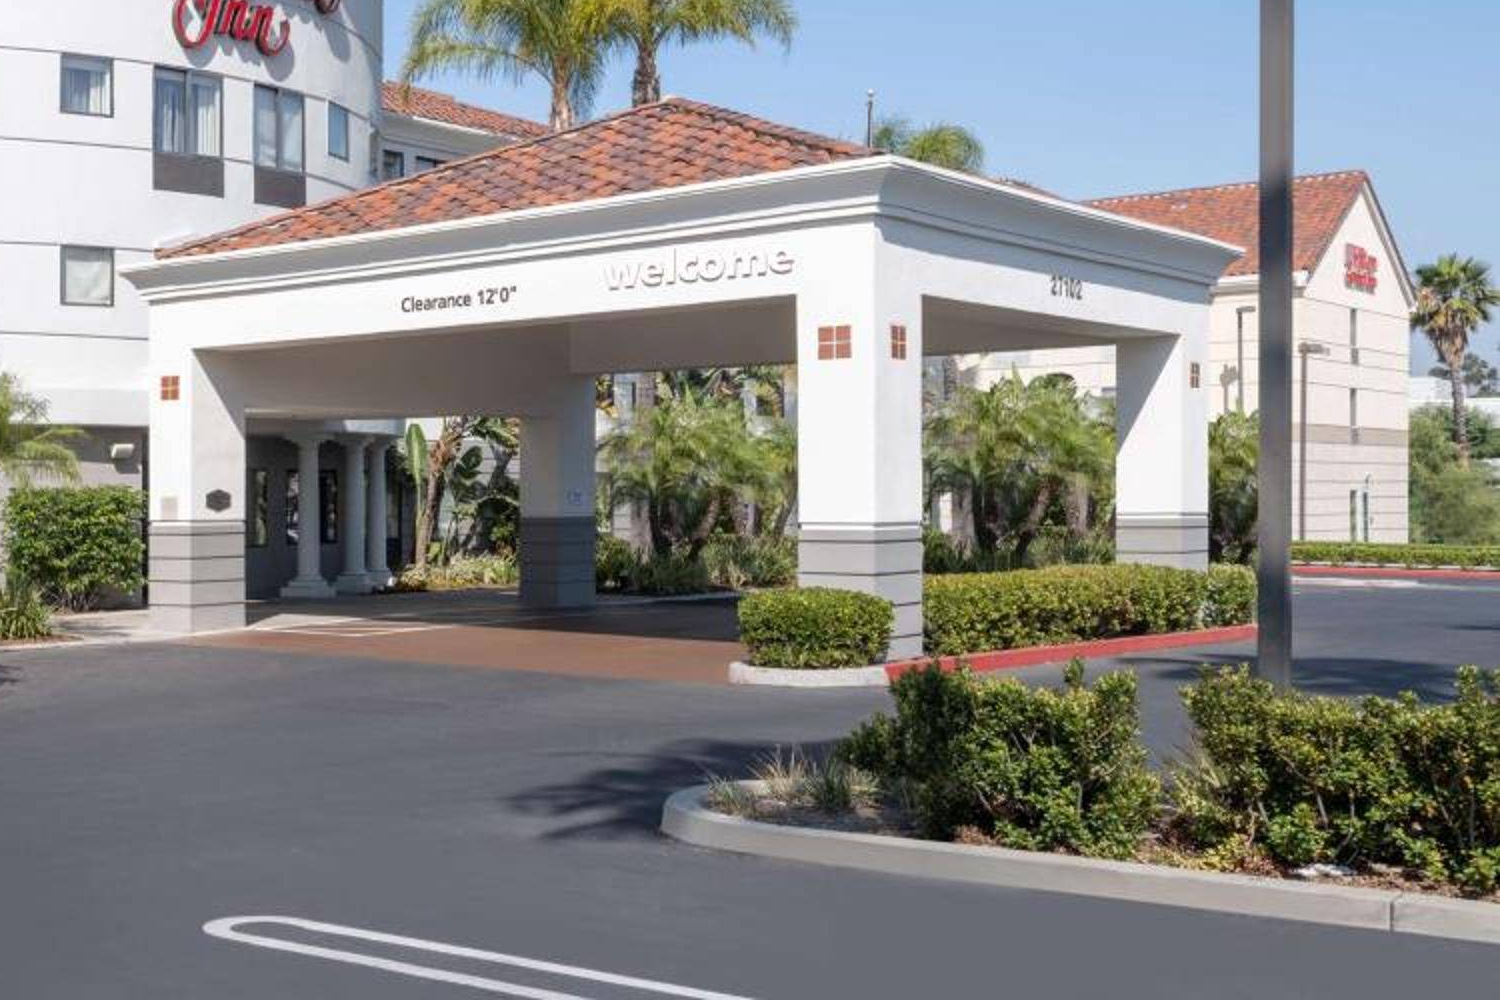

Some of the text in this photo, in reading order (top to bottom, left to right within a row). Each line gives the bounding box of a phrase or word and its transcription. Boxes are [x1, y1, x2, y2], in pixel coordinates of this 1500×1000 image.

[603, 248, 795, 291] welcome
[401, 285, 517, 313] Clearance 12'0"
